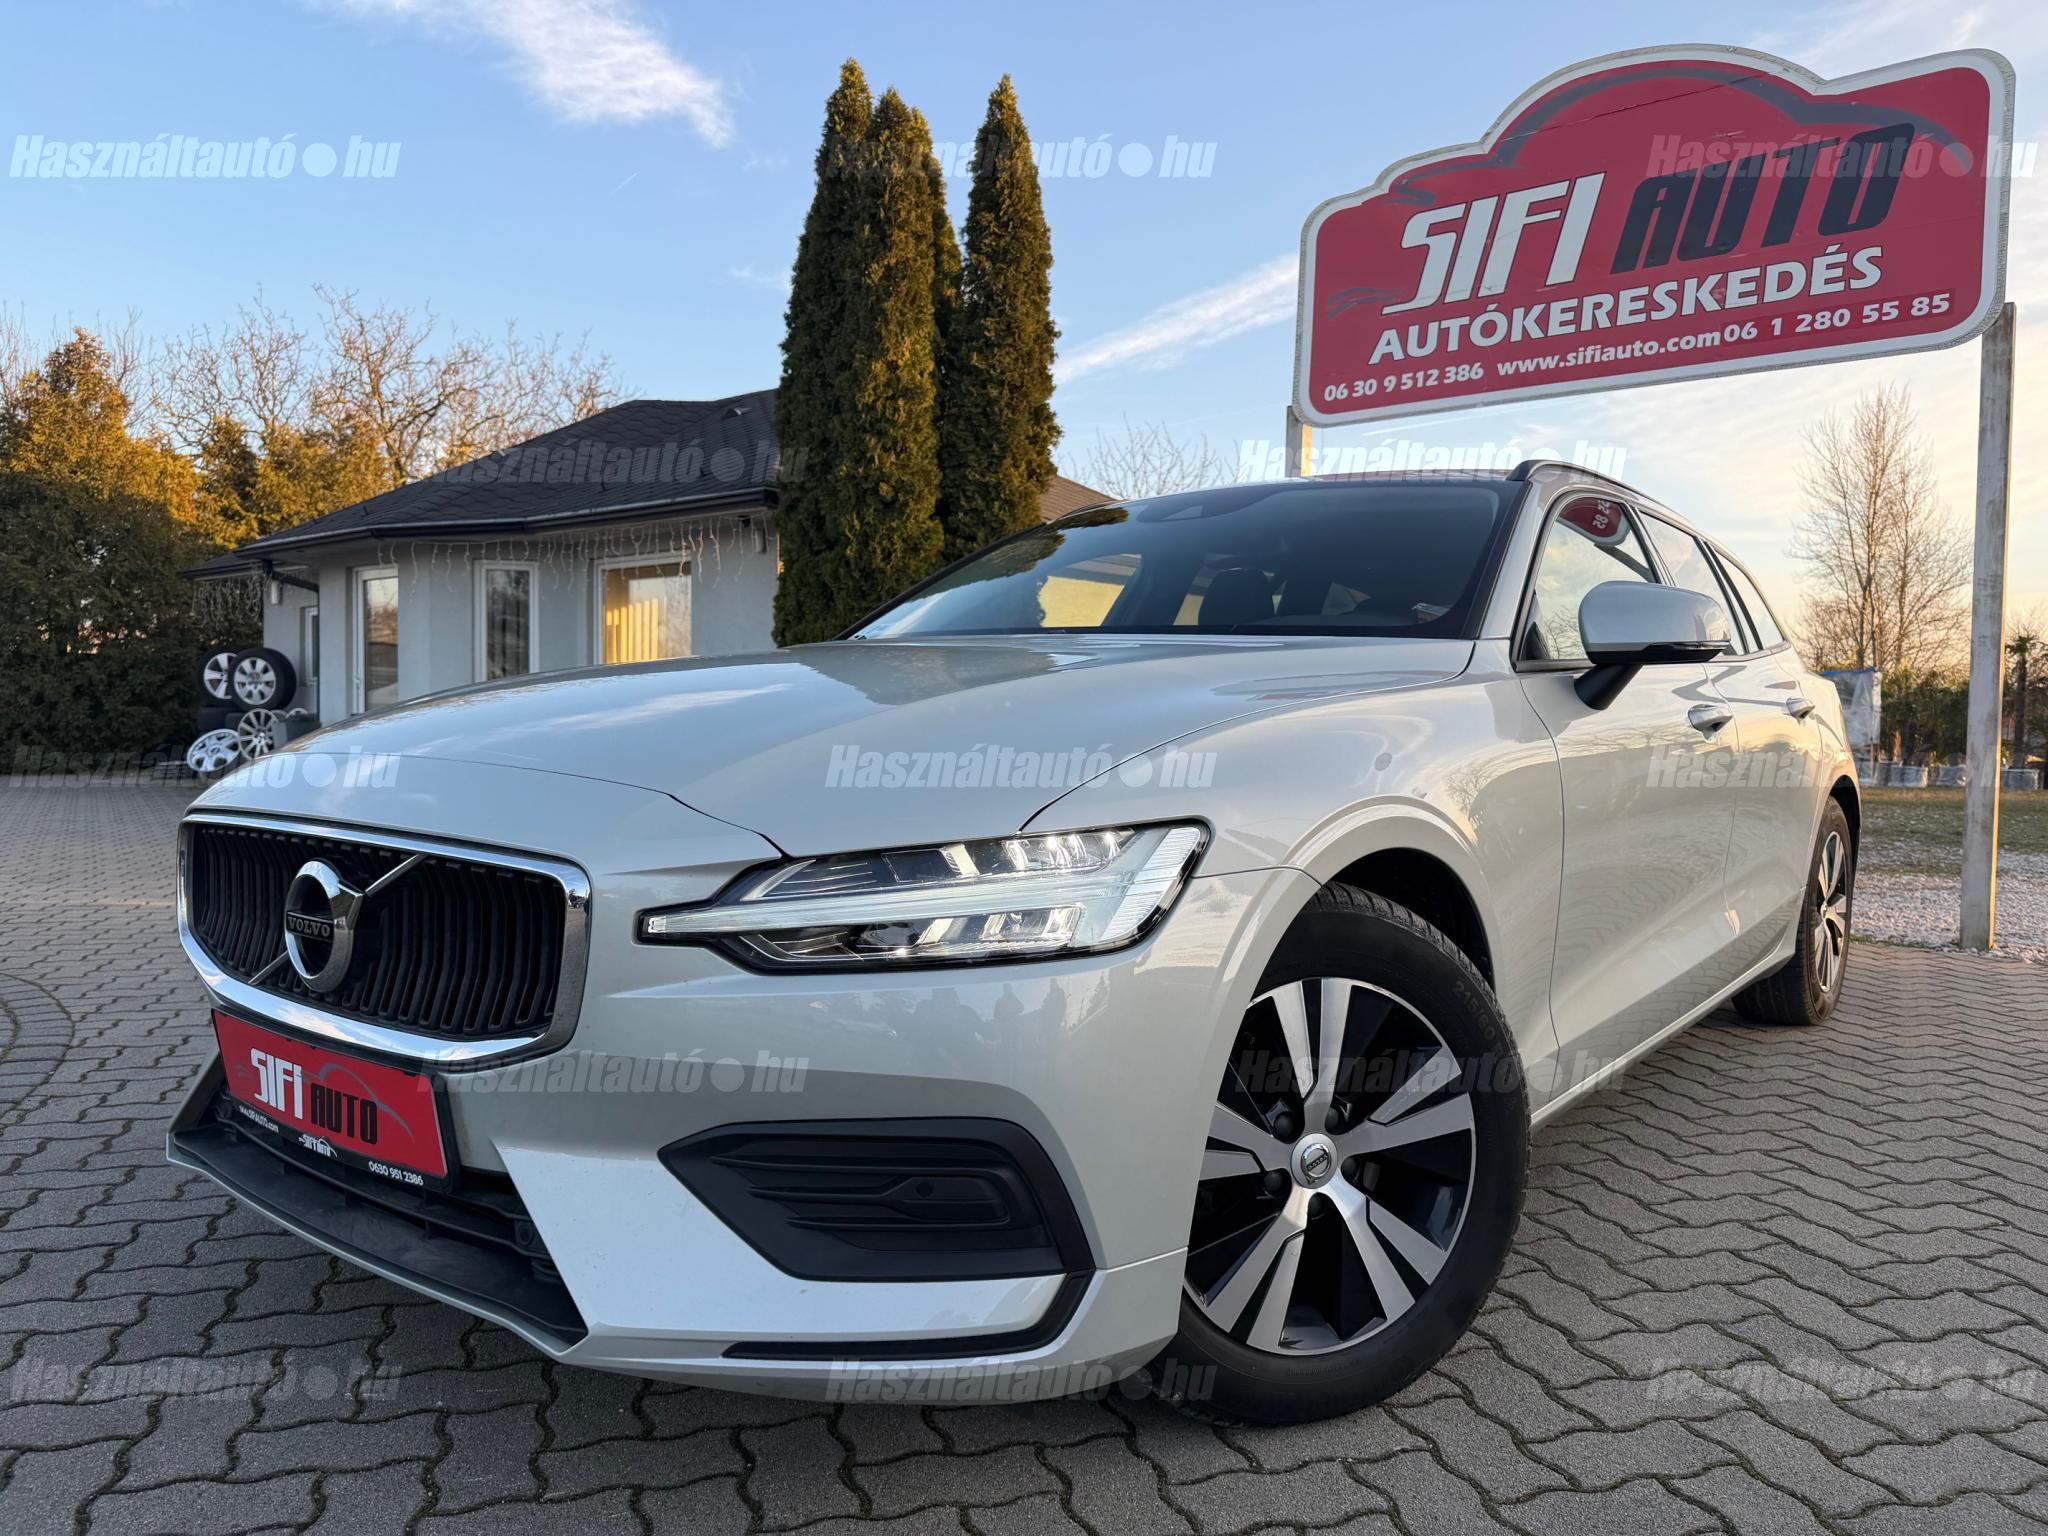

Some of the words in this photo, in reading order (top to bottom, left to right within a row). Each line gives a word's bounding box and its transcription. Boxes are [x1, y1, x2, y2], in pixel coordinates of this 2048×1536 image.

[1382, 171, 1606, 315] SIFI
[1610, 123, 1915, 275] AUTO
[1368, 243, 1883, 365] AUTÓKERESKEDÉS
[1723, 322, 1758, 343] 06
[1770, 317, 1782, 336] 1
[1794, 308, 1850, 333] 280
[1861, 301, 1899, 324] 55
[1911, 293, 1950, 317] 85
[1324, 383, 1348, 401] 06
[1352, 379, 1377, 397] 30
[1443, 362, 1484, 384] 386
[1497, 331, 1720, 376] www.sifiauto.com
[288, 916, 330, 937] VOLVO
[250, 1047, 303, 1120] SIFI
[310, 1082, 377, 1145] AUTO
[368, 1160, 389, 1176] 0630
[389, 1167, 403, 1181] 951
[403, 1172, 424, 1186] 2386
